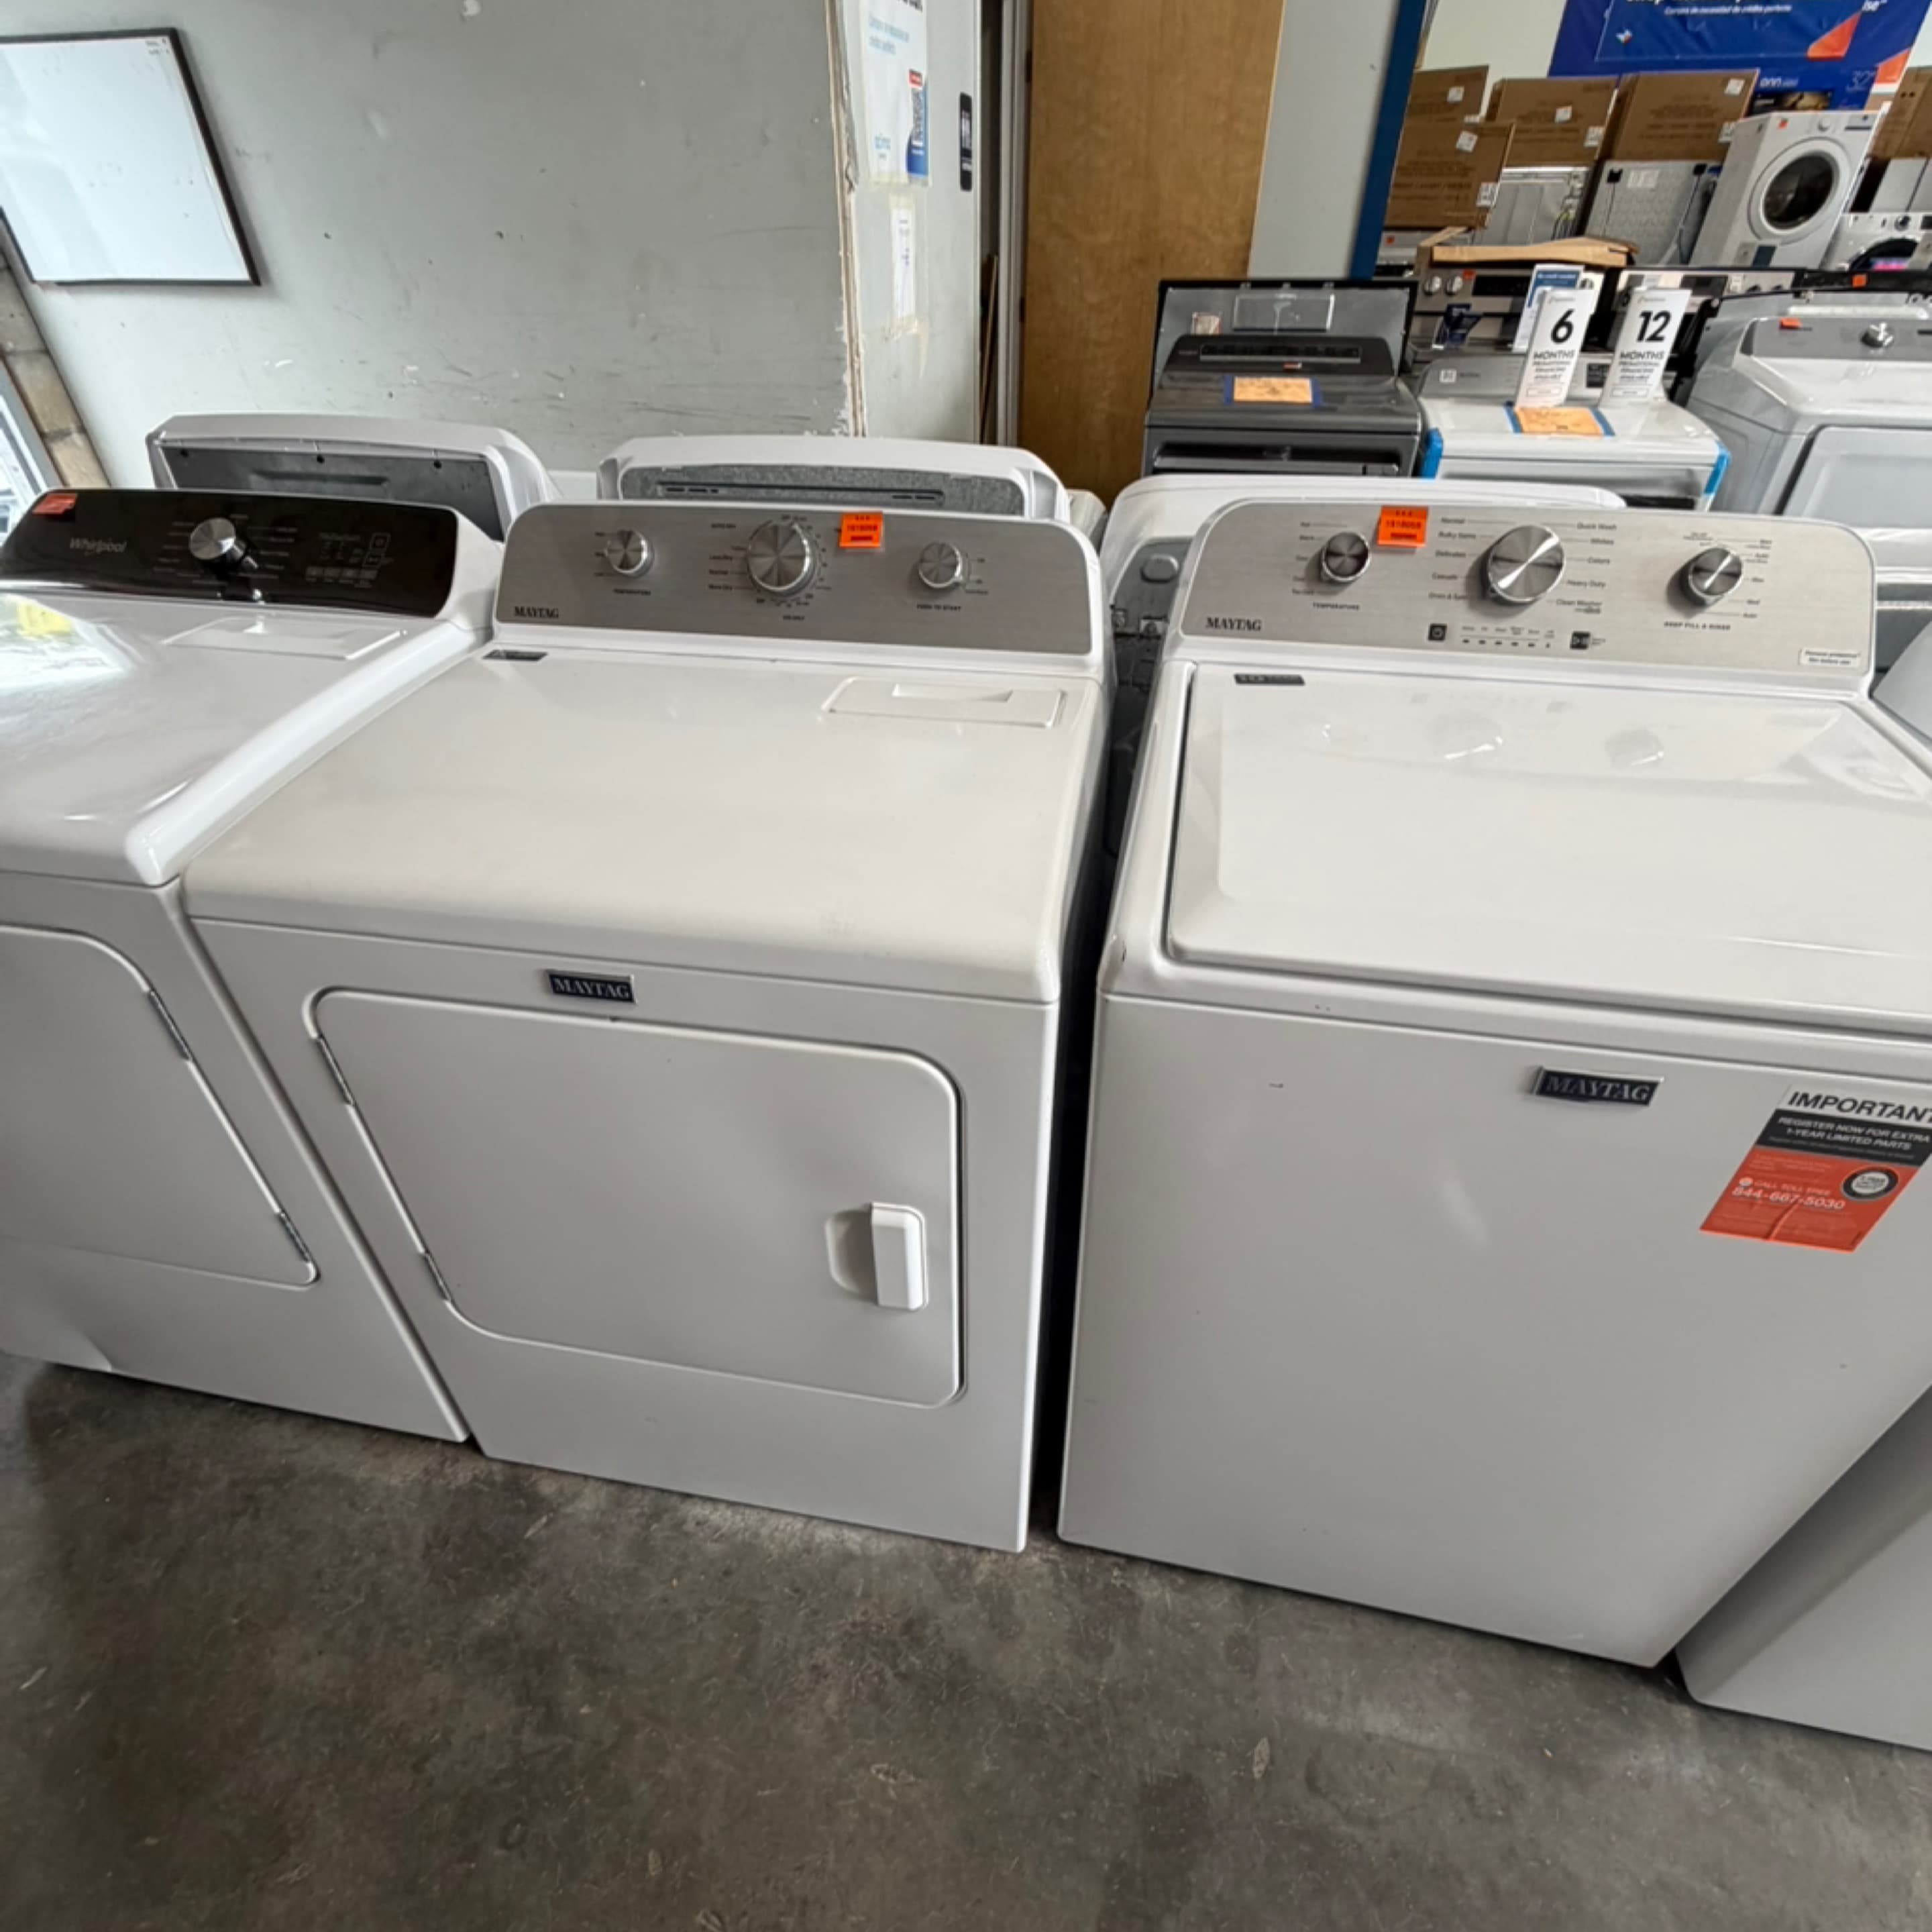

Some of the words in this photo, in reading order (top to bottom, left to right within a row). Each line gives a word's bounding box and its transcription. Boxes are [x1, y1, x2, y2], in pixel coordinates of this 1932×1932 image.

[1551, 308, 1575, 344] 6
[1637, 310, 1671, 342] 12
[1534, 350, 1576, 360] MONTHS
[1620, 350, 1664, 361] MONTHS
[69, 537, 127, 555] Whirlpool
[514, 605, 559, 619] MAYTAG
[1205, 616, 1263, 632] MAYTAG
[553, 977, 629, 999] MAYTAG
[1546, 1075, 1651, 1102] MAYTAG
[1778, 1116, 1835, 1130] REGISTER
[1835, 1123, 1864, 1134] NOW
[1865, 1126, 1890, 1138] FOR
[1891, 1130, 1931, 1143] EXTRA
[1786, 1127, 1826, 1140] 1-YEAR
[1826, 1132, 1872, 1145] LIMITED
[1872, 1138, 1912, 1150] PARTS
